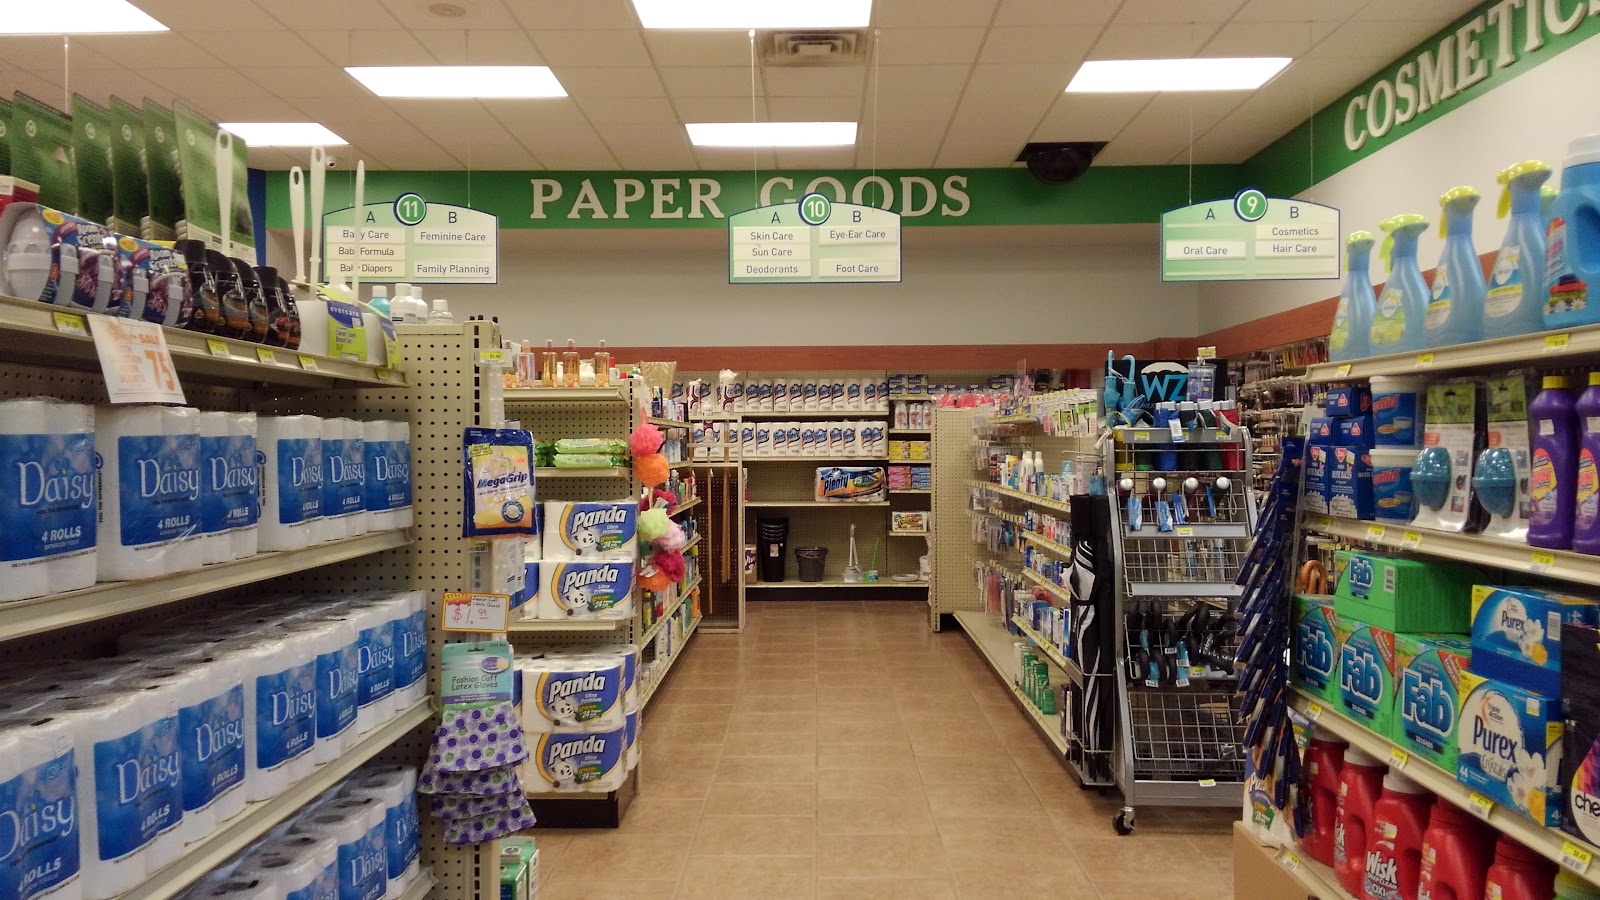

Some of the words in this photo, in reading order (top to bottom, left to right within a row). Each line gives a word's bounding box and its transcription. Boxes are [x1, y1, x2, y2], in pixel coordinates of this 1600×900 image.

[531, 178, 724, 220] PAPER
[1247, 196, 1258, 214] 9
[366, 211, 376, 223] A
[404, 201, 418, 217] 11
[449, 212, 457, 223] B
[808, 201, 825, 218] 10
[853, 211, 861, 222] B
[1206, 208, 1215, 220] A
[1290, 207, 1299, 218] B
[771, 212, 781, 224] A
[343, 230, 365, 240] Bay
[368, 231, 389, 239] Care
[421, 232, 463, 240] Feminine
[465, 233, 486, 241] Care
[751, 232, 770, 240] Skin
[866, 230, 886, 238] Care
[1272, 228, 1319, 236] Cosmetics
[360, 248, 394, 256] Formula
[752, 248, 768, 256] Sun
[772, 248, 792, 256] Care
[1184, 247, 1203, 255] Oral
[1206, 247, 1228, 255] Care
[1273, 245, 1292, 253] Hair
[362, 265, 392, 274] Diapers
[417, 265, 447, 274] Family
[450, 265, 490, 275] Planning
[746, 265, 798, 274] Deodorants
[330, 307, 360, 317] evercare
[1141, 374, 1189, 402] WZ
[210, 457, 257, 494] Daisy
[291, 457, 323, 489] Daisy
[330, 456, 365, 485] Daisy
[375, 456, 409, 484] Daisy
[17, 462, 94, 509] Daisy
[138, 459, 199, 500] Daisy
[477, 472, 528, 489] MegaGrip
[347, 496, 360, 505] ROLLS
[233, 507, 249, 518] ROLLS
[570, 505, 628, 535] Panda
[158, 520, 163, 528] 4
[165, 515, 190, 528] ROLLS
[42, 531, 48, 542] 4
[50, 526, 82, 542] ROLLS
[562, 564, 619, 594] Panda
[1350, 558, 1373, 587] Fab
[1502, 611, 1527, 635] Purex
[1297, 623, 1334, 677] Fab
[358, 645, 395, 674] Daisy
[1341, 644, 1383, 705] Fab
[375, 679, 390, 692] ROLLS
[452, 683, 472, 691] Latex
[548, 671, 606, 705] Panda
[272, 690, 316, 726] Daisy
[1403, 667, 1454, 737] Fab
[1488, 703, 1500, 712] Triple
[1489, 711, 1504, 721] Action
[196, 720, 244, 762] Daisy
[291, 732, 308, 748] ROLLS
[1474, 715, 1518, 764] Purex
[548, 734, 606, 766] Panda
[1481, 753, 1506, 778] Crystals
[117, 752, 179, 804] Daisy
[212, 775, 217, 787] 4
[217, 764, 238, 783] ROLLS
[1575, 792, 1600, 818] che
[140, 820, 146, 832] 4
[146, 804, 170, 829] ROLLS
[351, 846, 386, 887] Daisy
[1366, 851, 1397, 884] Wisk
[1372, 884, 1386, 897] OXI
